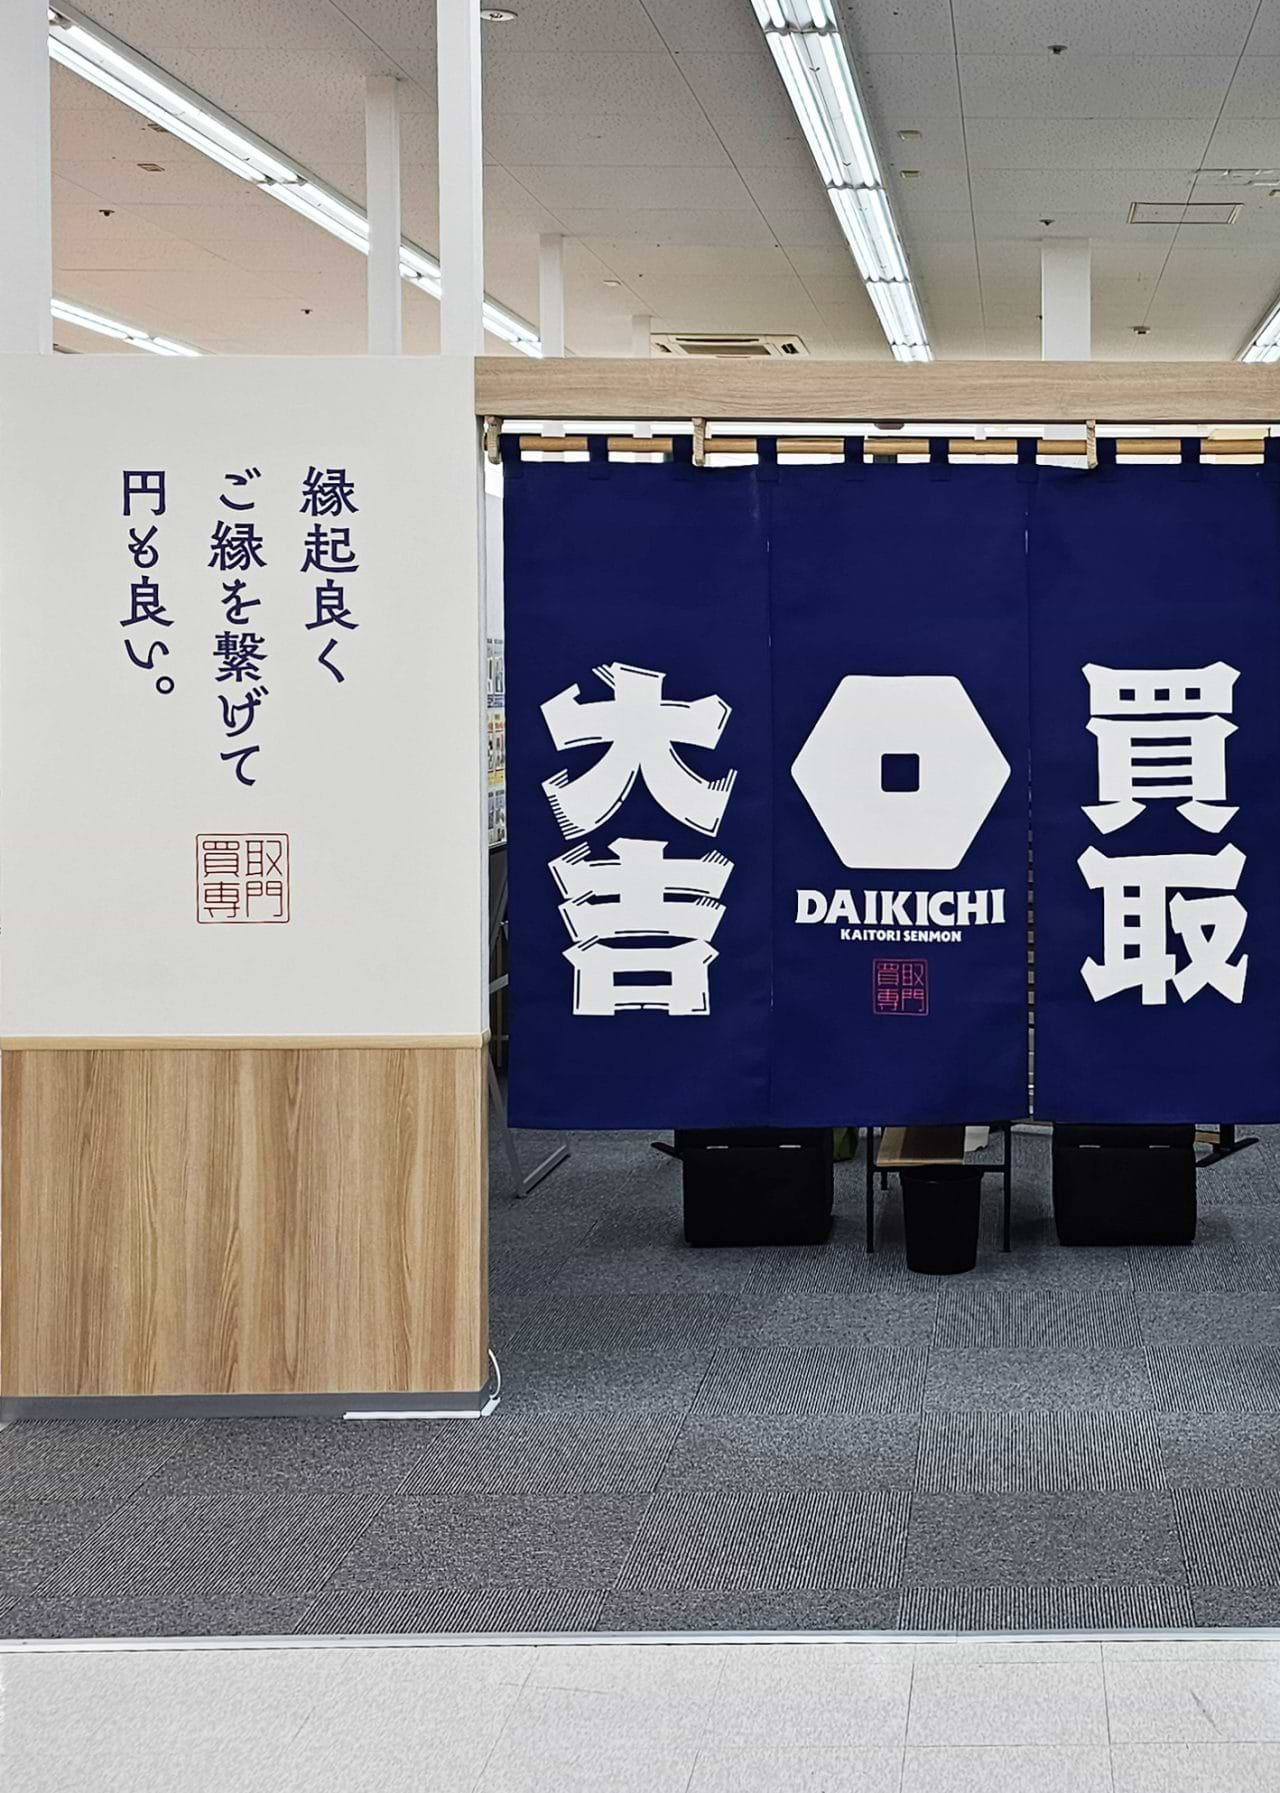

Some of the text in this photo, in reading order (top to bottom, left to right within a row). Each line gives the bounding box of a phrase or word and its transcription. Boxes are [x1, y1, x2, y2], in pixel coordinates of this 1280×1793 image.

[120, 470, 175, 695] 円も良い。
[207, 467, 269, 786] ご縁を繋げて
[299, 466, 360, 683] 縁起良く
[541, 662, 737, 1015] 大吉
[796, 889, 1005, 925] DAIKICHI
[841, 929, 961, 941] KAITORI SENMON
[1078, 662, 1248, 1004] 買取
